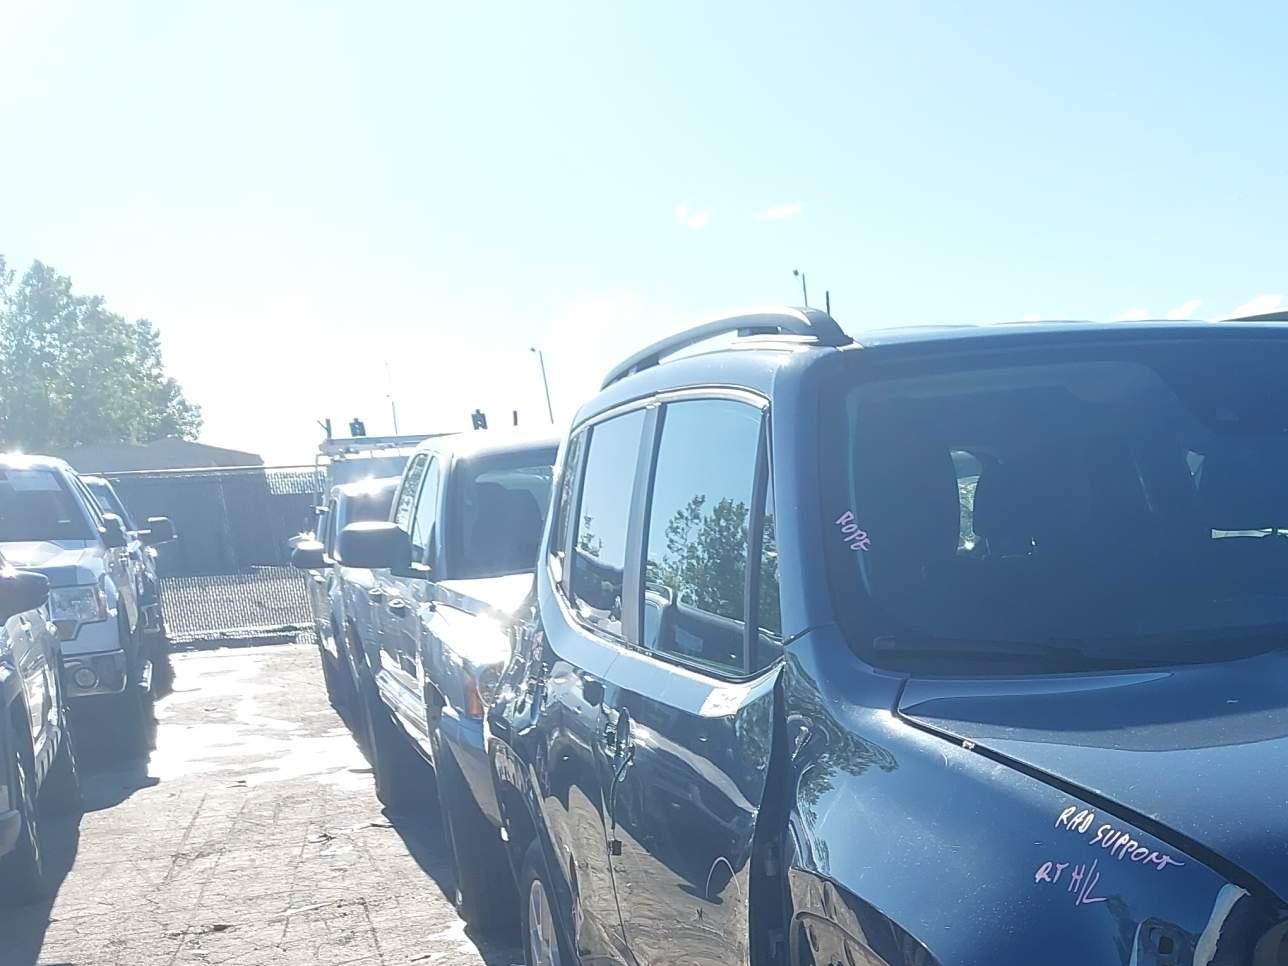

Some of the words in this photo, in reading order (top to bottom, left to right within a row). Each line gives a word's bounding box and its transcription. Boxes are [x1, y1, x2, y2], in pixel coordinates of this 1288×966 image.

[1055, 805, 1095, 834] RAD
[1089, 823, 1185, 871] SUPPORT
[1034, 861, 1069, 884] RT
[1068, 858, 1107, 906] H/L
